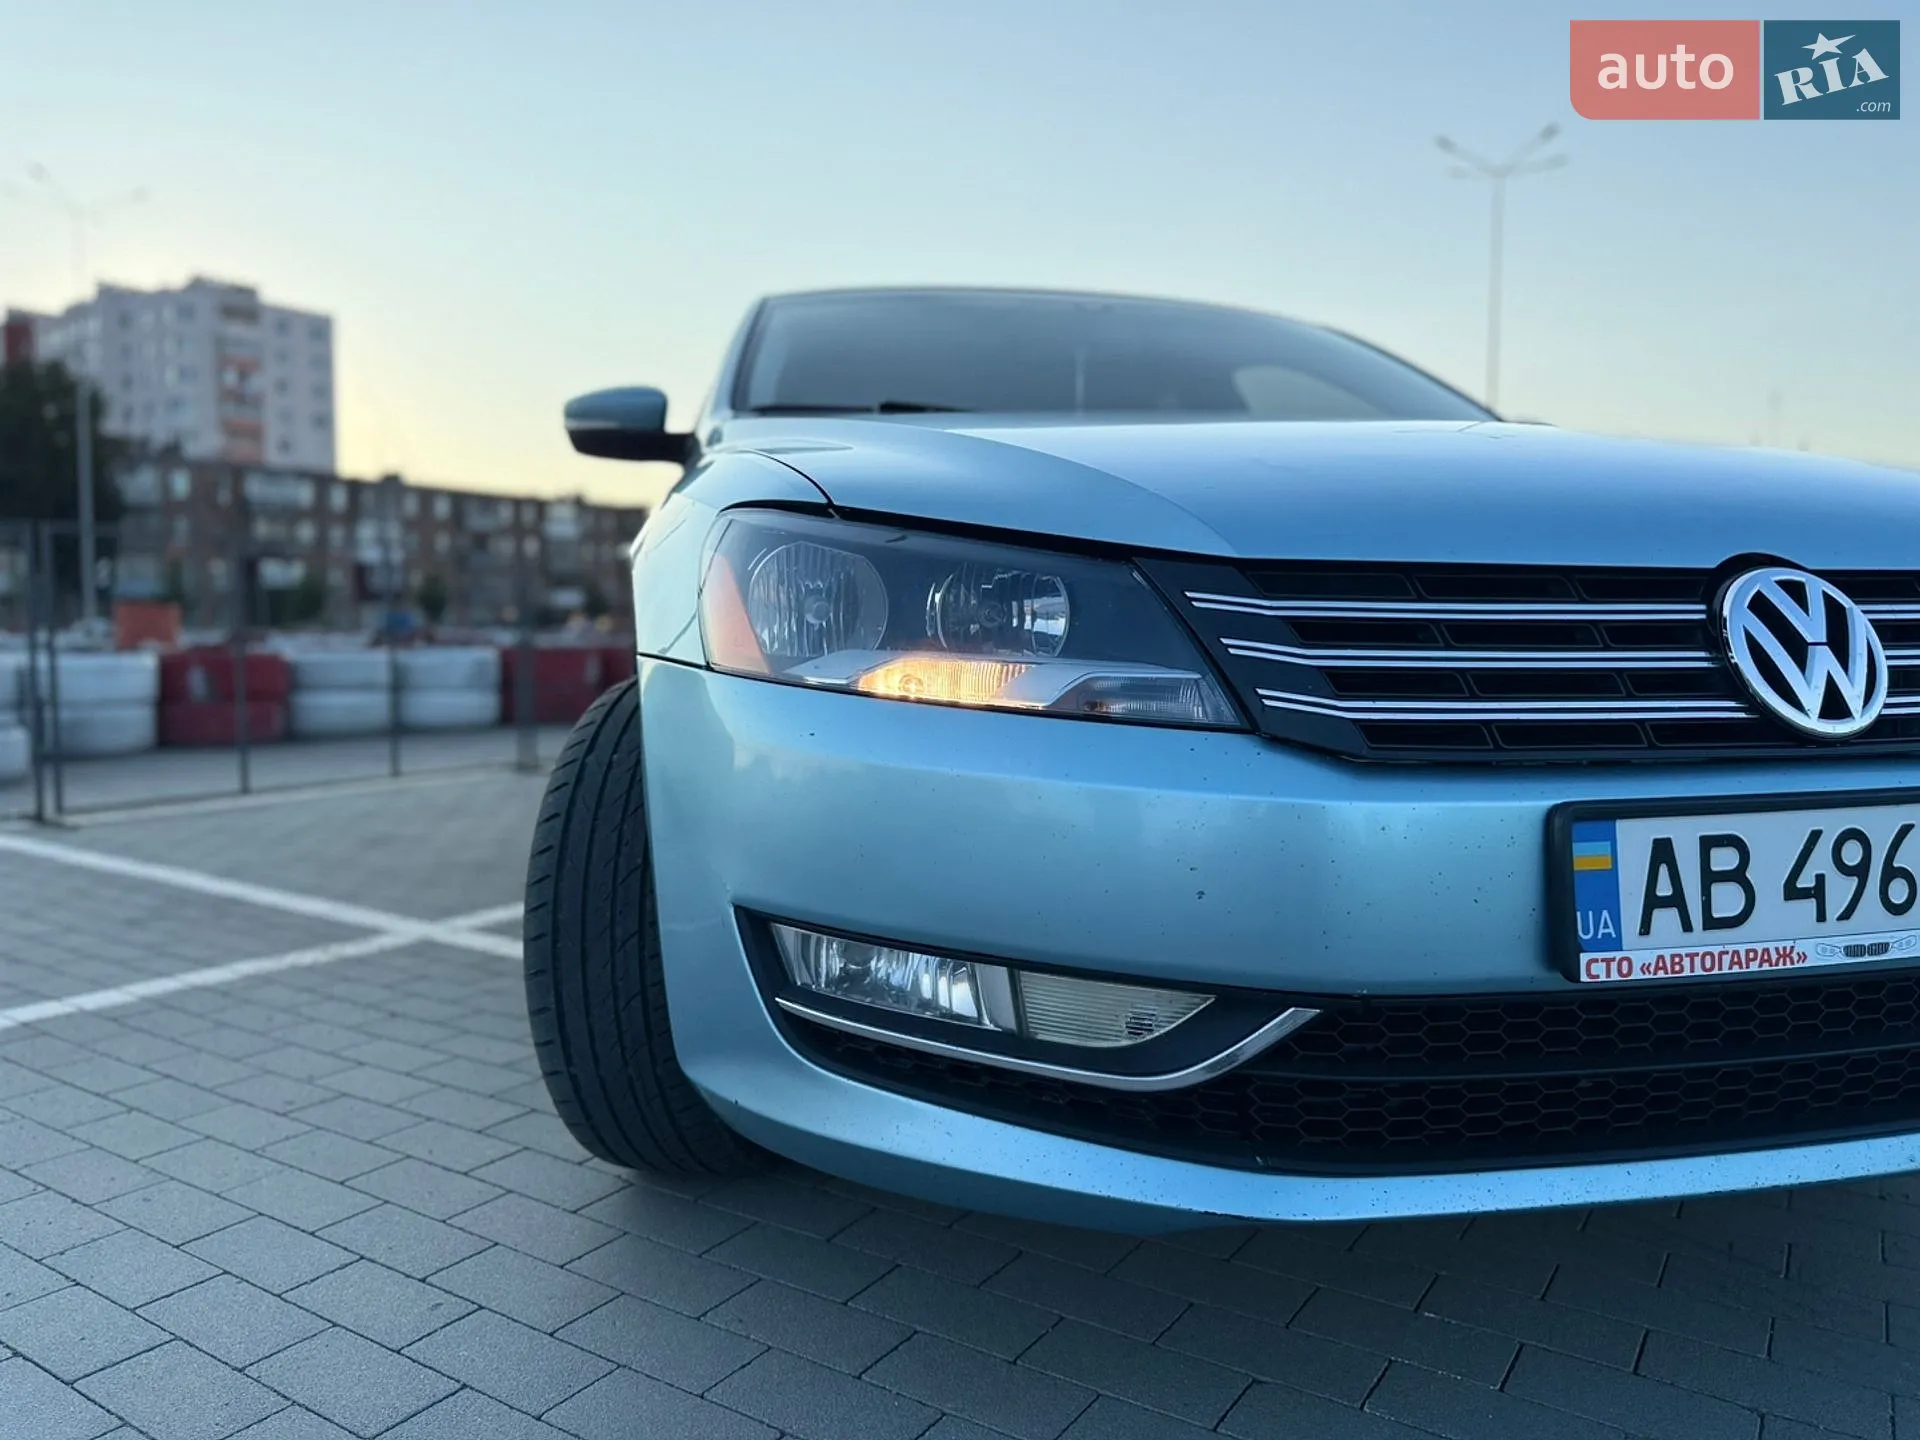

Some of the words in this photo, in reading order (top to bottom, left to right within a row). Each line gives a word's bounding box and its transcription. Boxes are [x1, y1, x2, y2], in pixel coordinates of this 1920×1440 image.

[1638, 833, 1756, 936] AB
[1783, 823, 1917, 922] 496
[1577, 909, 1616, 940] UA
[1585, 958, 1633, 980] СТО
[1640, 945, 1808, 976] «АВТОГАРАЖ»
